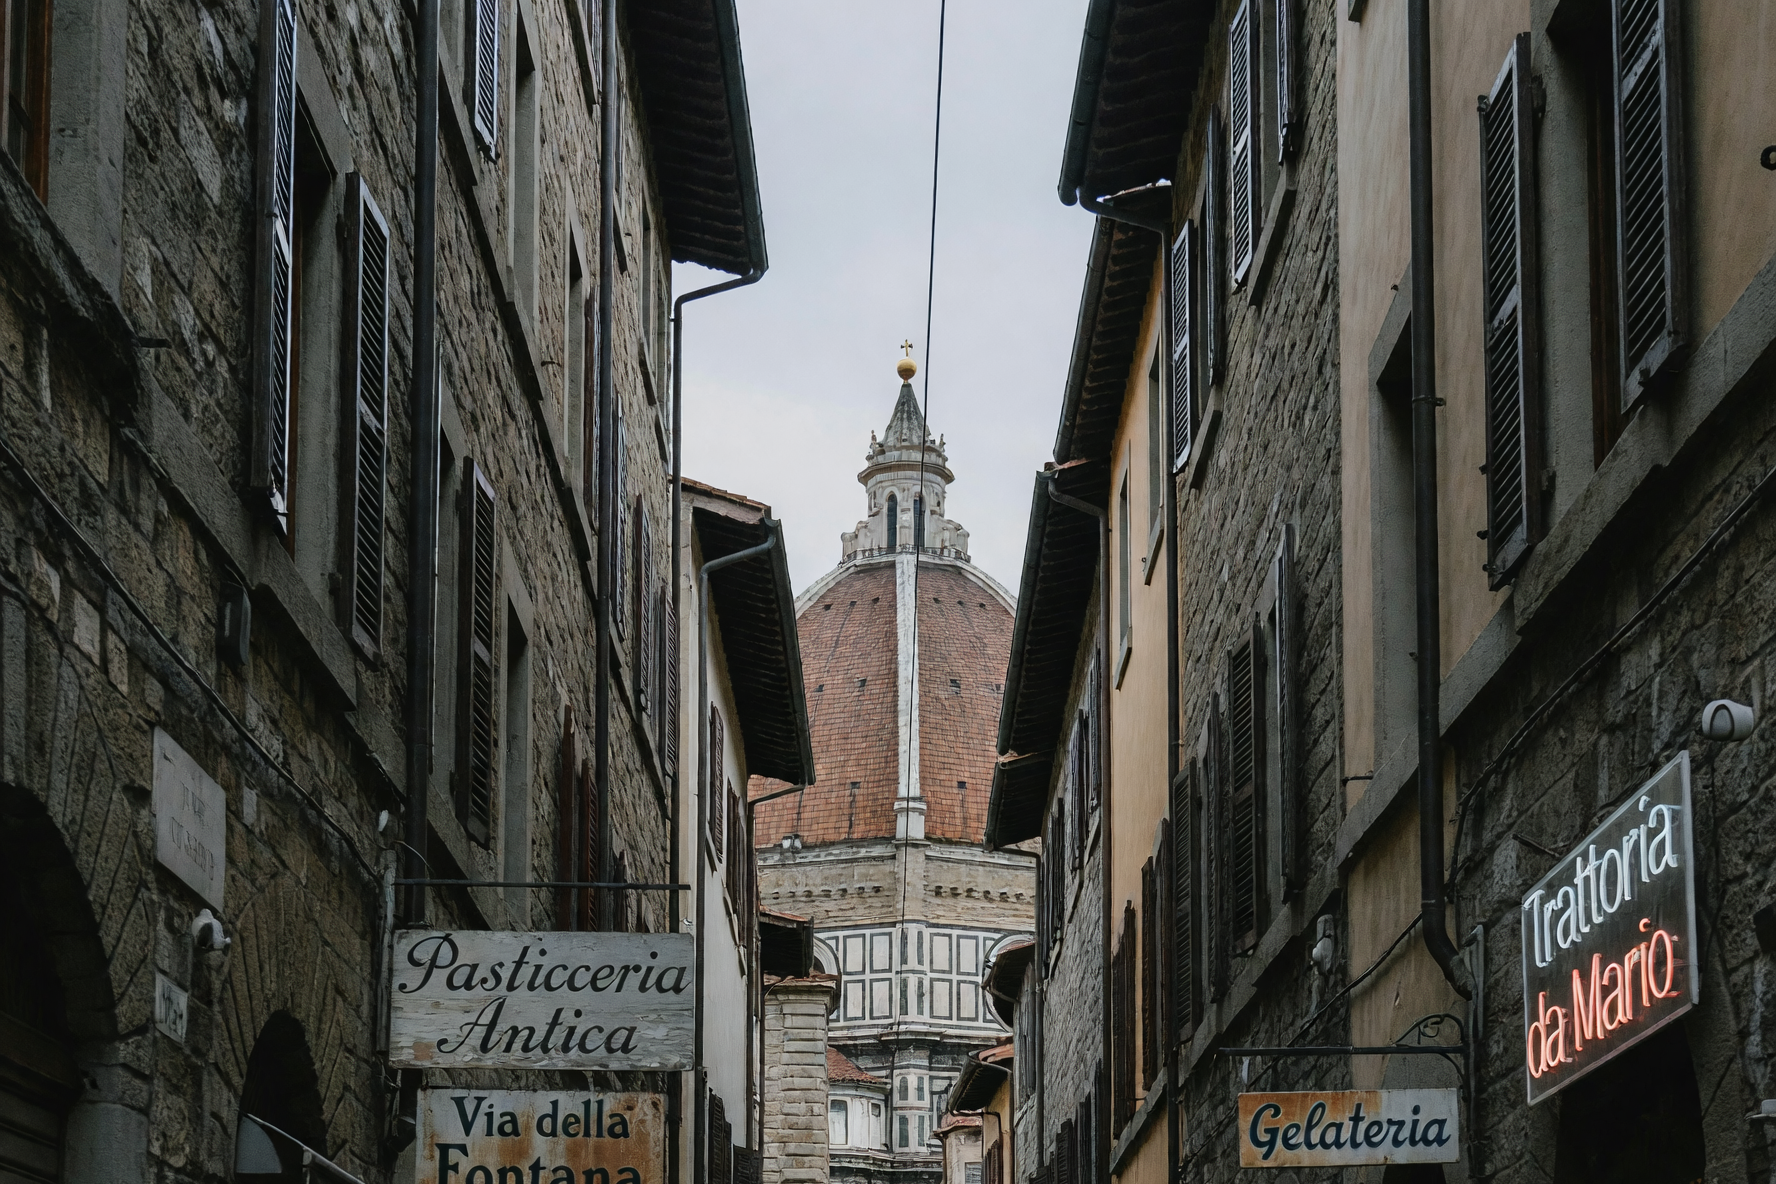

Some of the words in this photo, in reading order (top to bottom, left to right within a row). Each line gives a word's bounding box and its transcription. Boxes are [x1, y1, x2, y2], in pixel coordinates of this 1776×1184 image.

[1524, 795, 1680, 967] Trattoria
[398, 933, 691, 995] Pasticceria
[436, 996, 638, 1055] Antica
[1528, 991, 1568, 1078] da
[1573, 917, 1674, 1052] Mario
[450, 1096, 520, 1138] Via
[535, 1098, 630, 1139] della
[1249, 1100, 1451, 1161] Gelateria
